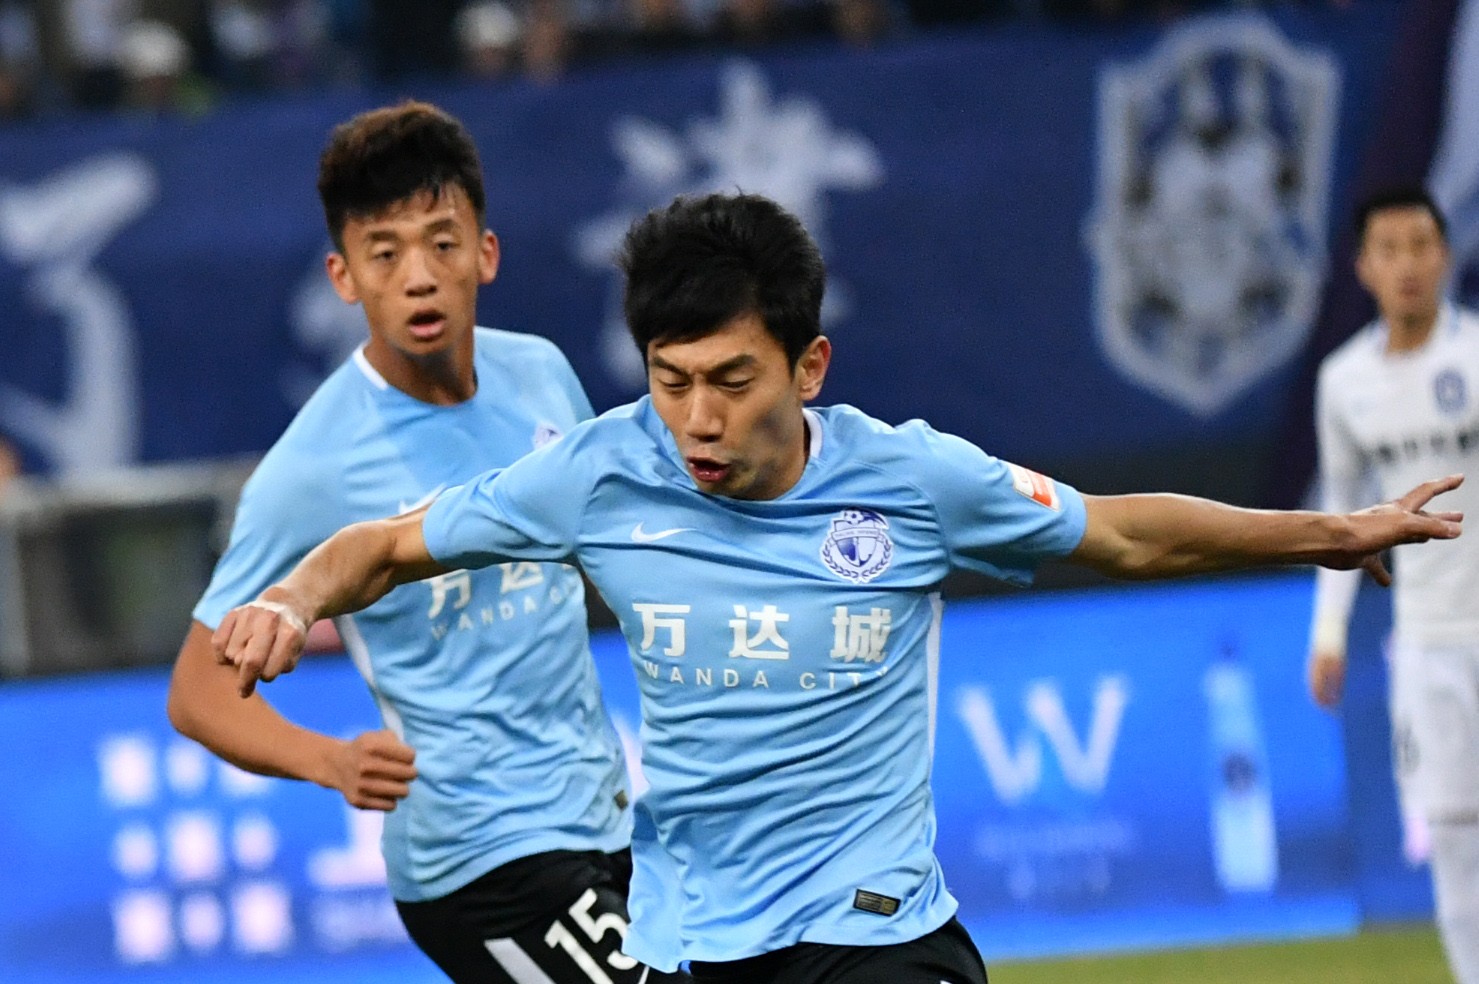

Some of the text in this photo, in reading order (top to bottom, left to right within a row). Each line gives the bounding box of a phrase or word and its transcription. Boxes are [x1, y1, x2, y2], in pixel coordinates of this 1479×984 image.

[421, 561, 573, 619] 万达
[632, 603, 891, 663] 万达城
[642, 659, 769, 688] WANDA
